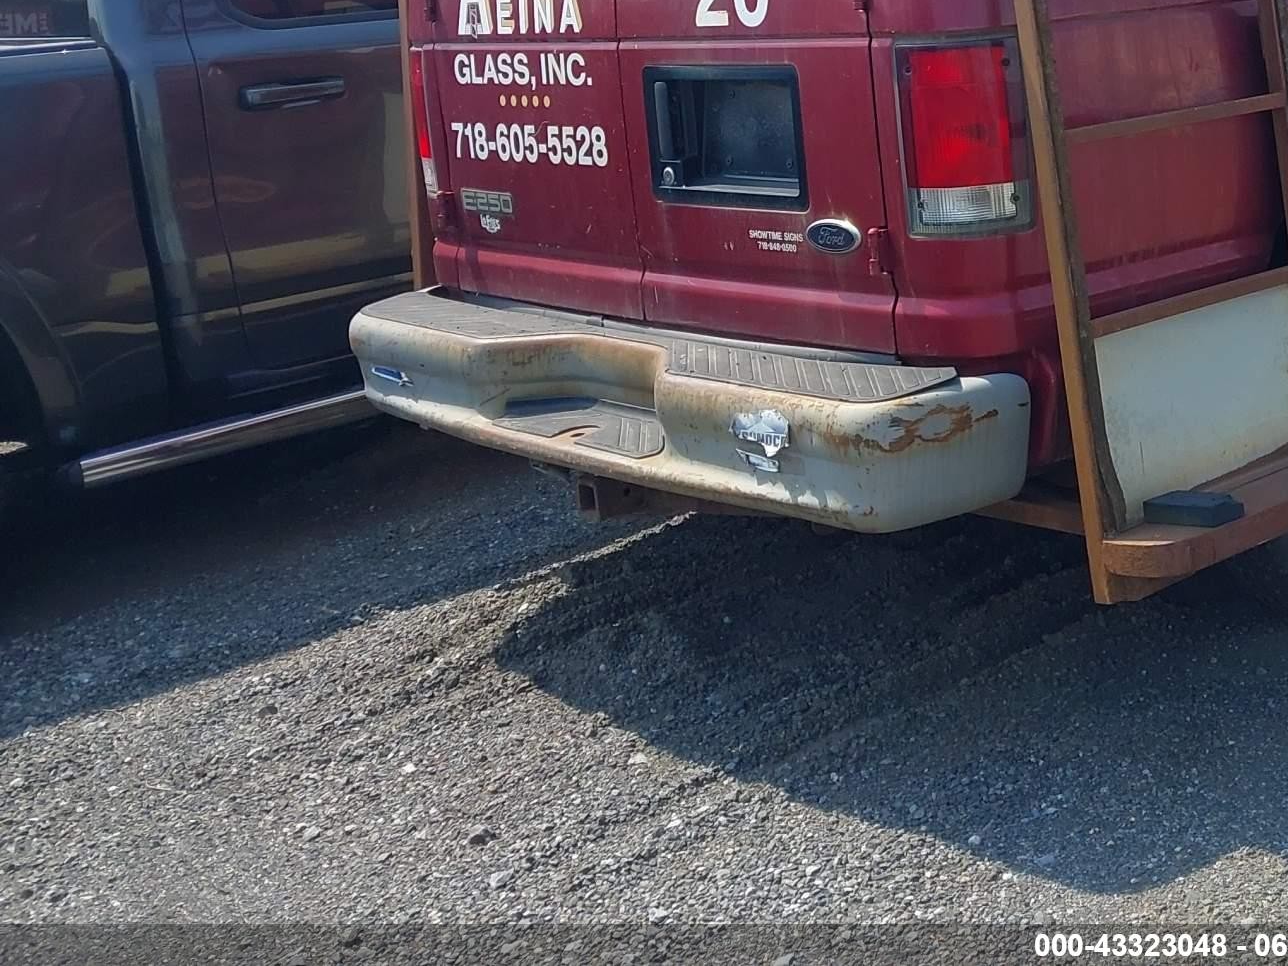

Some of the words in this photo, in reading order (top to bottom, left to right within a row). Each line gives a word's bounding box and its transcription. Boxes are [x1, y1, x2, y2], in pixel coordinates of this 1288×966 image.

[454, 52, 537, 91] GLASS,
[540, 52, 593, 86] INC.
[451, 122, 609, 167] 718-605-5528
[463, 191, 513, 213] E250
[748, 229, 783, 241] SHOWTIME
[783, 232, 804, 243] SIGNS
[818, 226, 845, 246] Ford
